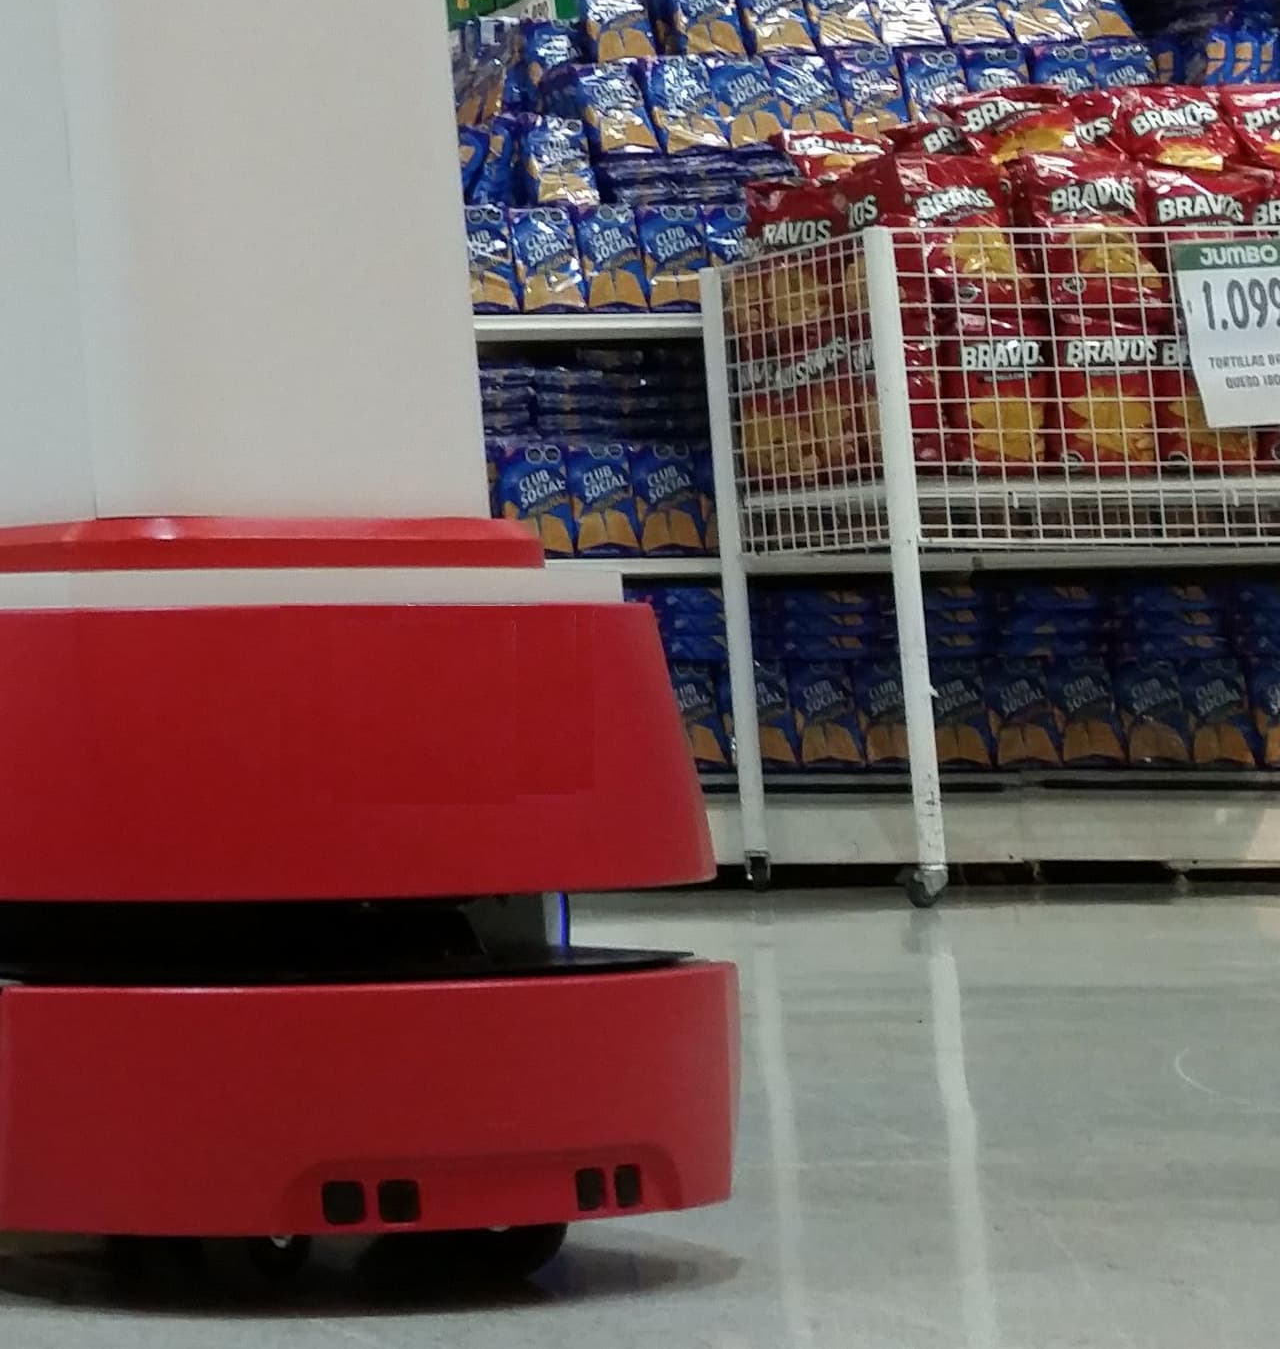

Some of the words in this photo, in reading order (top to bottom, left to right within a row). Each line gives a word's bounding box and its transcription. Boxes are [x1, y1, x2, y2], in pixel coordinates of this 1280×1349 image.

[726, 74, 755, 95] CLUB
[729, 81, 771, 108] SOCIAL
[1131, 100, 1219, 136] BRAVOS
[915, 188, 996, 221] BRAVOS
[1050, 178, 1136, 213] BRAVOS
[1157, 193, 1245, 225] BRAVOS
[592, 227, 622, 247] CLUB
[655, 226, 685, 246] CLUB
[762, 218, 832, 246] RAVOS
[594, 235, 638, 264] SOCIAL
[657, 235, 701, 263] SOCIAL
[1200, 243, 1279, 266] JUMBO
[1064, 337, 1158, 368] BRAVOS
[1208, 353, 1265, 370] TORTILLAS
[518, 469, 551, 492] CLUB
[583, 465, 613, 487] CLUB
[584, 474, 629, 504] SOCIAL
[646, 465, 678, 488] CLUB
[648, 474, 693, 504] SOCIAL
[520, 478, 566, 509] SOCIAL
